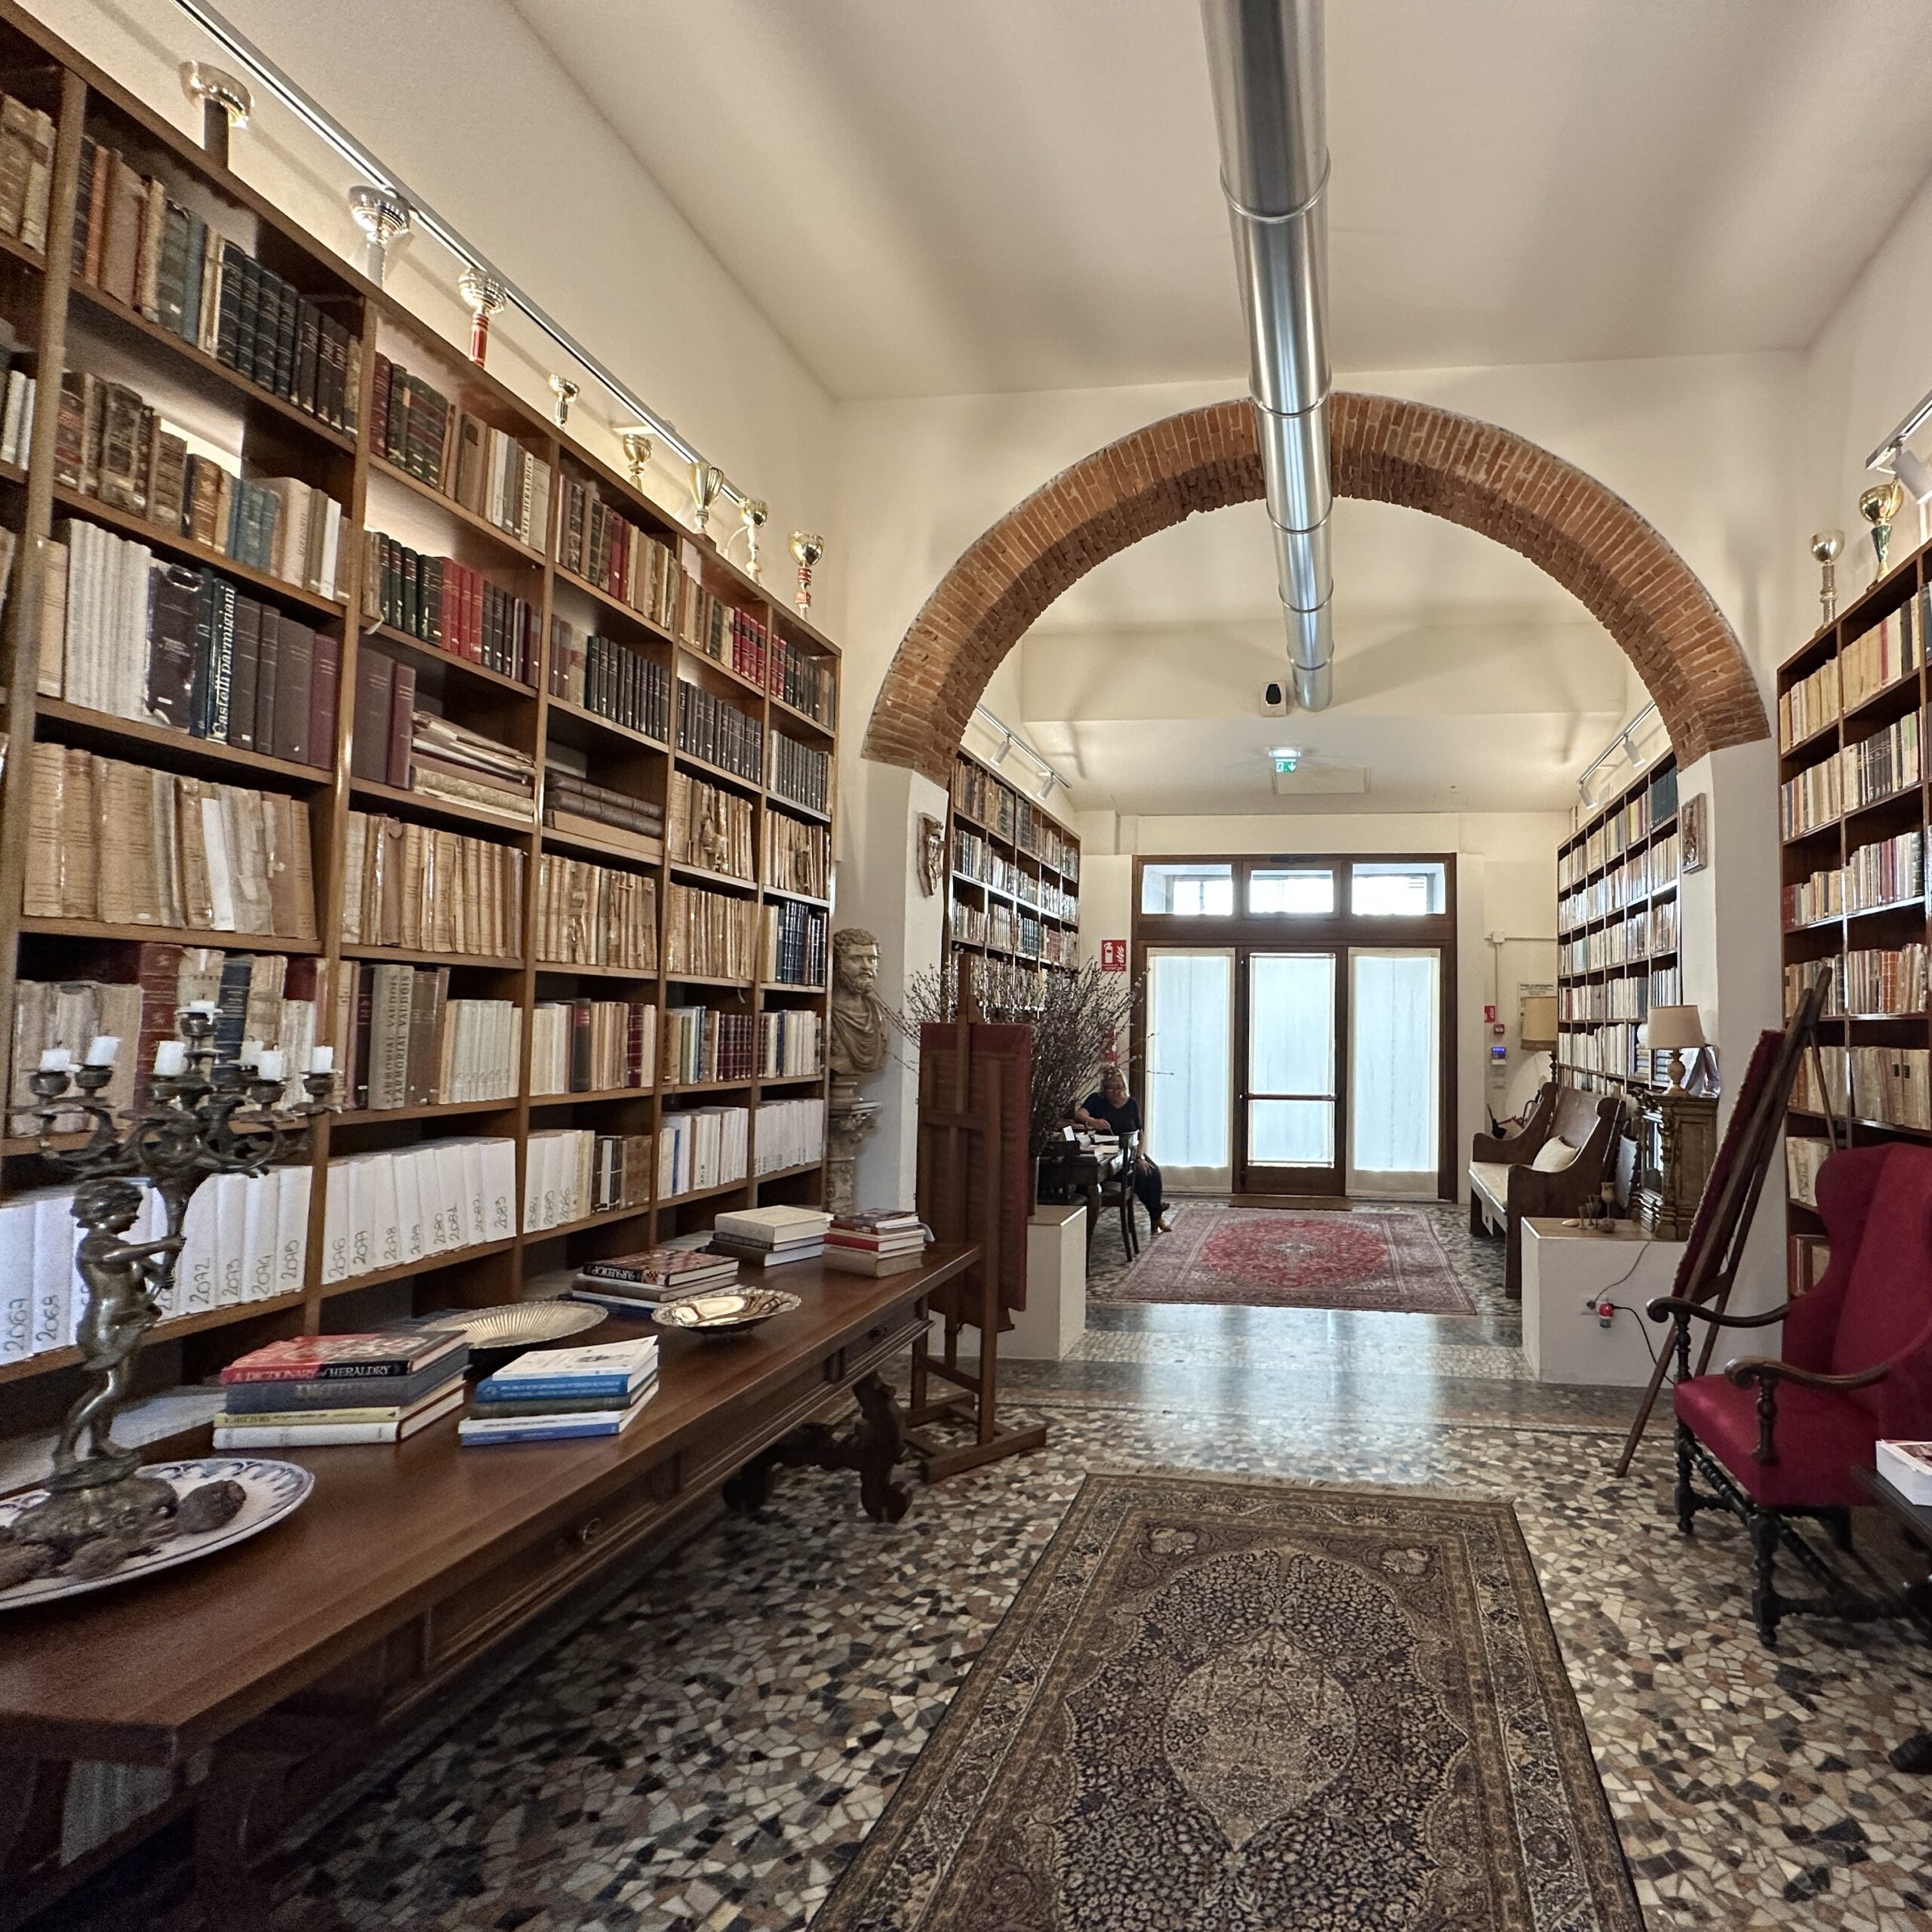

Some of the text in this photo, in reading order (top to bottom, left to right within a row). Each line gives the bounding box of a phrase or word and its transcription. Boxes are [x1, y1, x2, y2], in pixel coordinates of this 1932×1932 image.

[524, 457, 532, 512] HERALDICA
[212, 586, 235, 737] Castelli parmigiani
[397, 976, 410, 1027] VAUDOIS
[384, 975, 398, 1096] ARMORIAL VAUDOIS
[394, 1035, 406, 1094] ARMORIAL
[434, 1213, 446, 1244] 2080
[494, 1195, 507, 1229] 2083
[281, 1240, 300, 1279] 2075
[328, 1238, 346, 1278] 2076
[385, 1226, 397, 1260] 2078
[189, 1256, 211, 1305] 2072
[222, 1258, 242, 1297] 2073
[251, 1254, 274, 1294] 2074
[35, 1294, 61, 1342] 2068
[234, 1371, 243, 1383] A
[245, 1368, 317, 1383] DICTIONARY
[331, 1365, 392, 1377] HERALDRY
